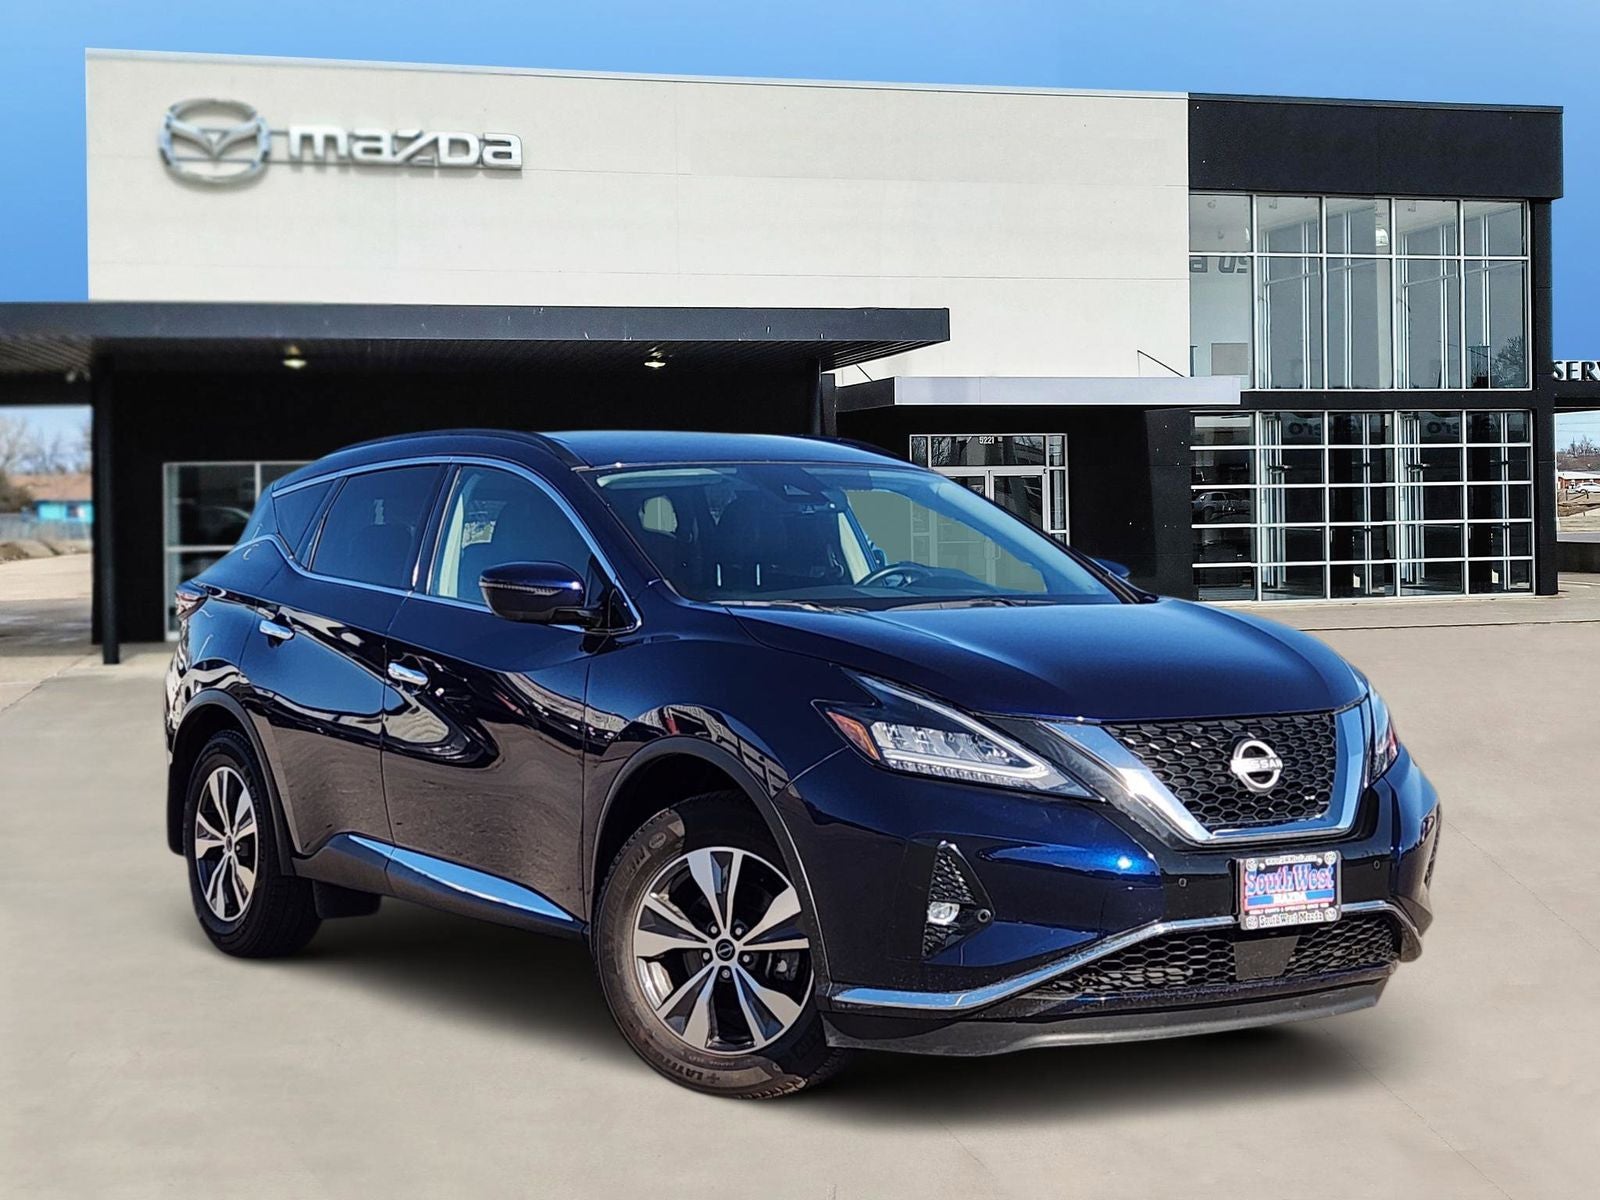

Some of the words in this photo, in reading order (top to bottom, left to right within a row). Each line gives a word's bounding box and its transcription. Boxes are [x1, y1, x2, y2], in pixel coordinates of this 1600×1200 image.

[288, 124, 523, 169] mazda
[979, 436, 994, 444] 5221
[1231, 758, 1283, 772] SSAN
